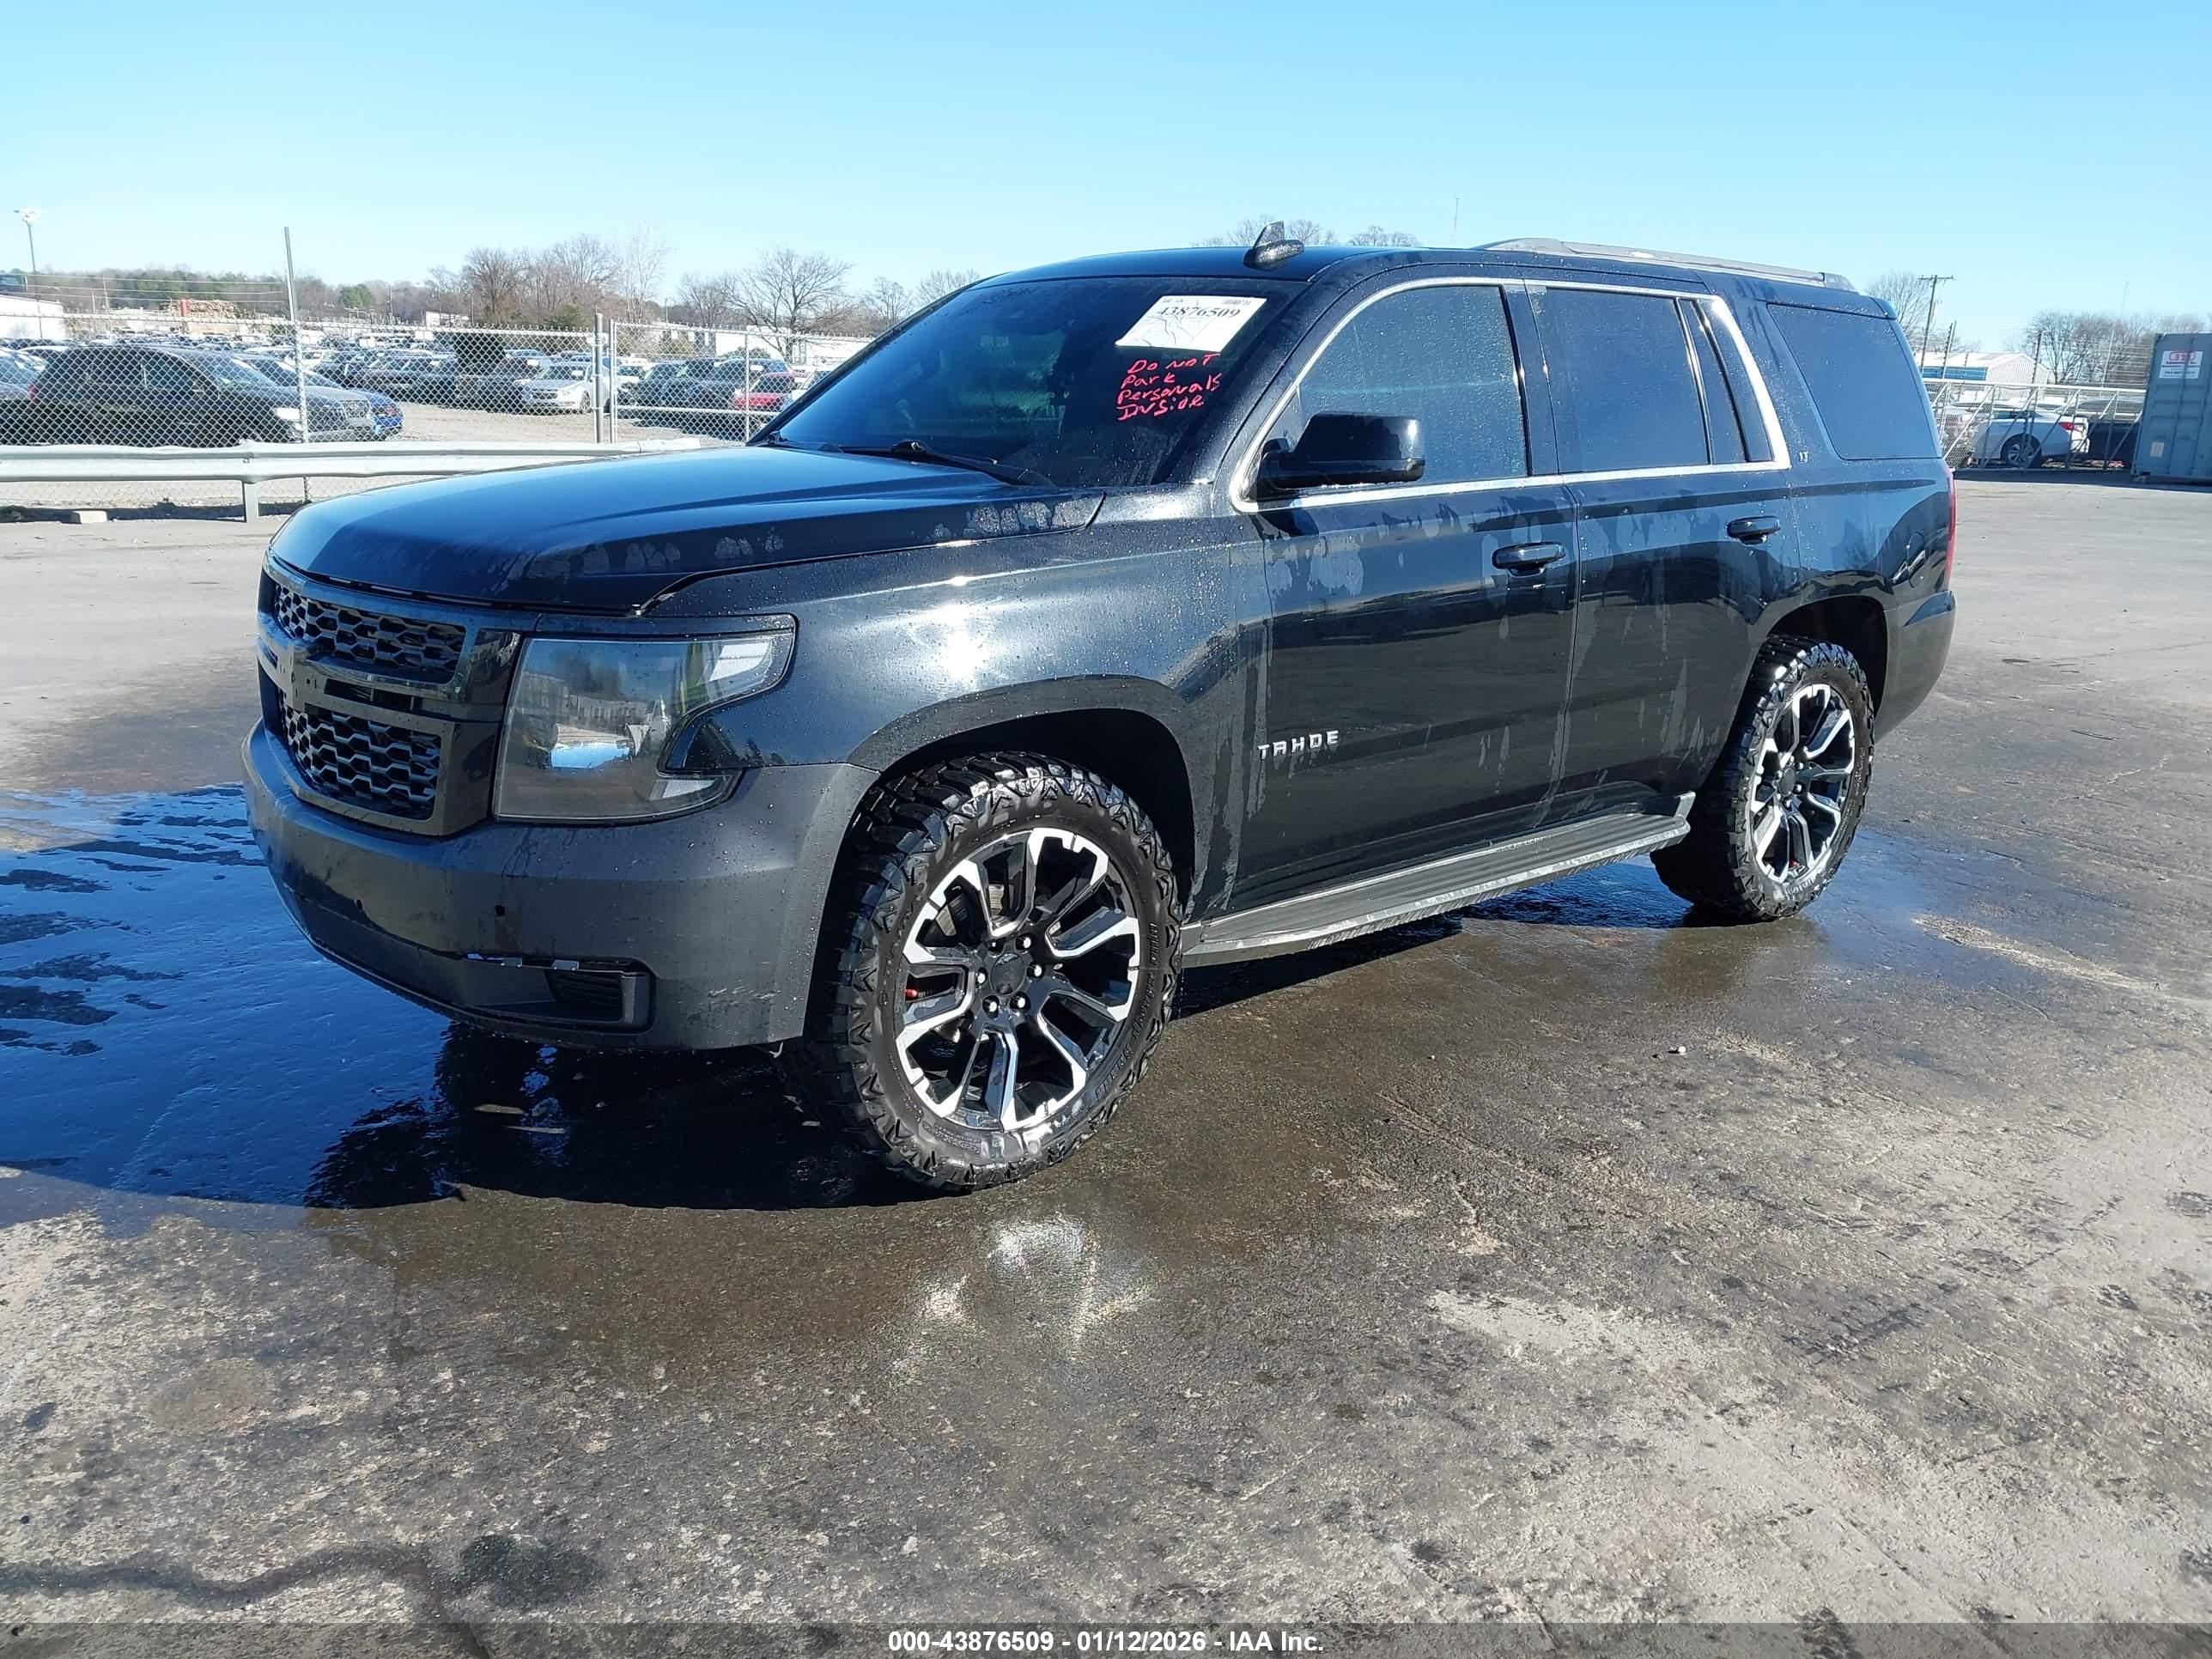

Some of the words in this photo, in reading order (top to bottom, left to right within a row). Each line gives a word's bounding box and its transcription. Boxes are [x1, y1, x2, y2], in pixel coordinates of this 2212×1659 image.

[1157, 306, 1241, 318] 43876509
[1127, 359, 1158, 374] Do
[1257, 730, 1339, 760] TAHOE
